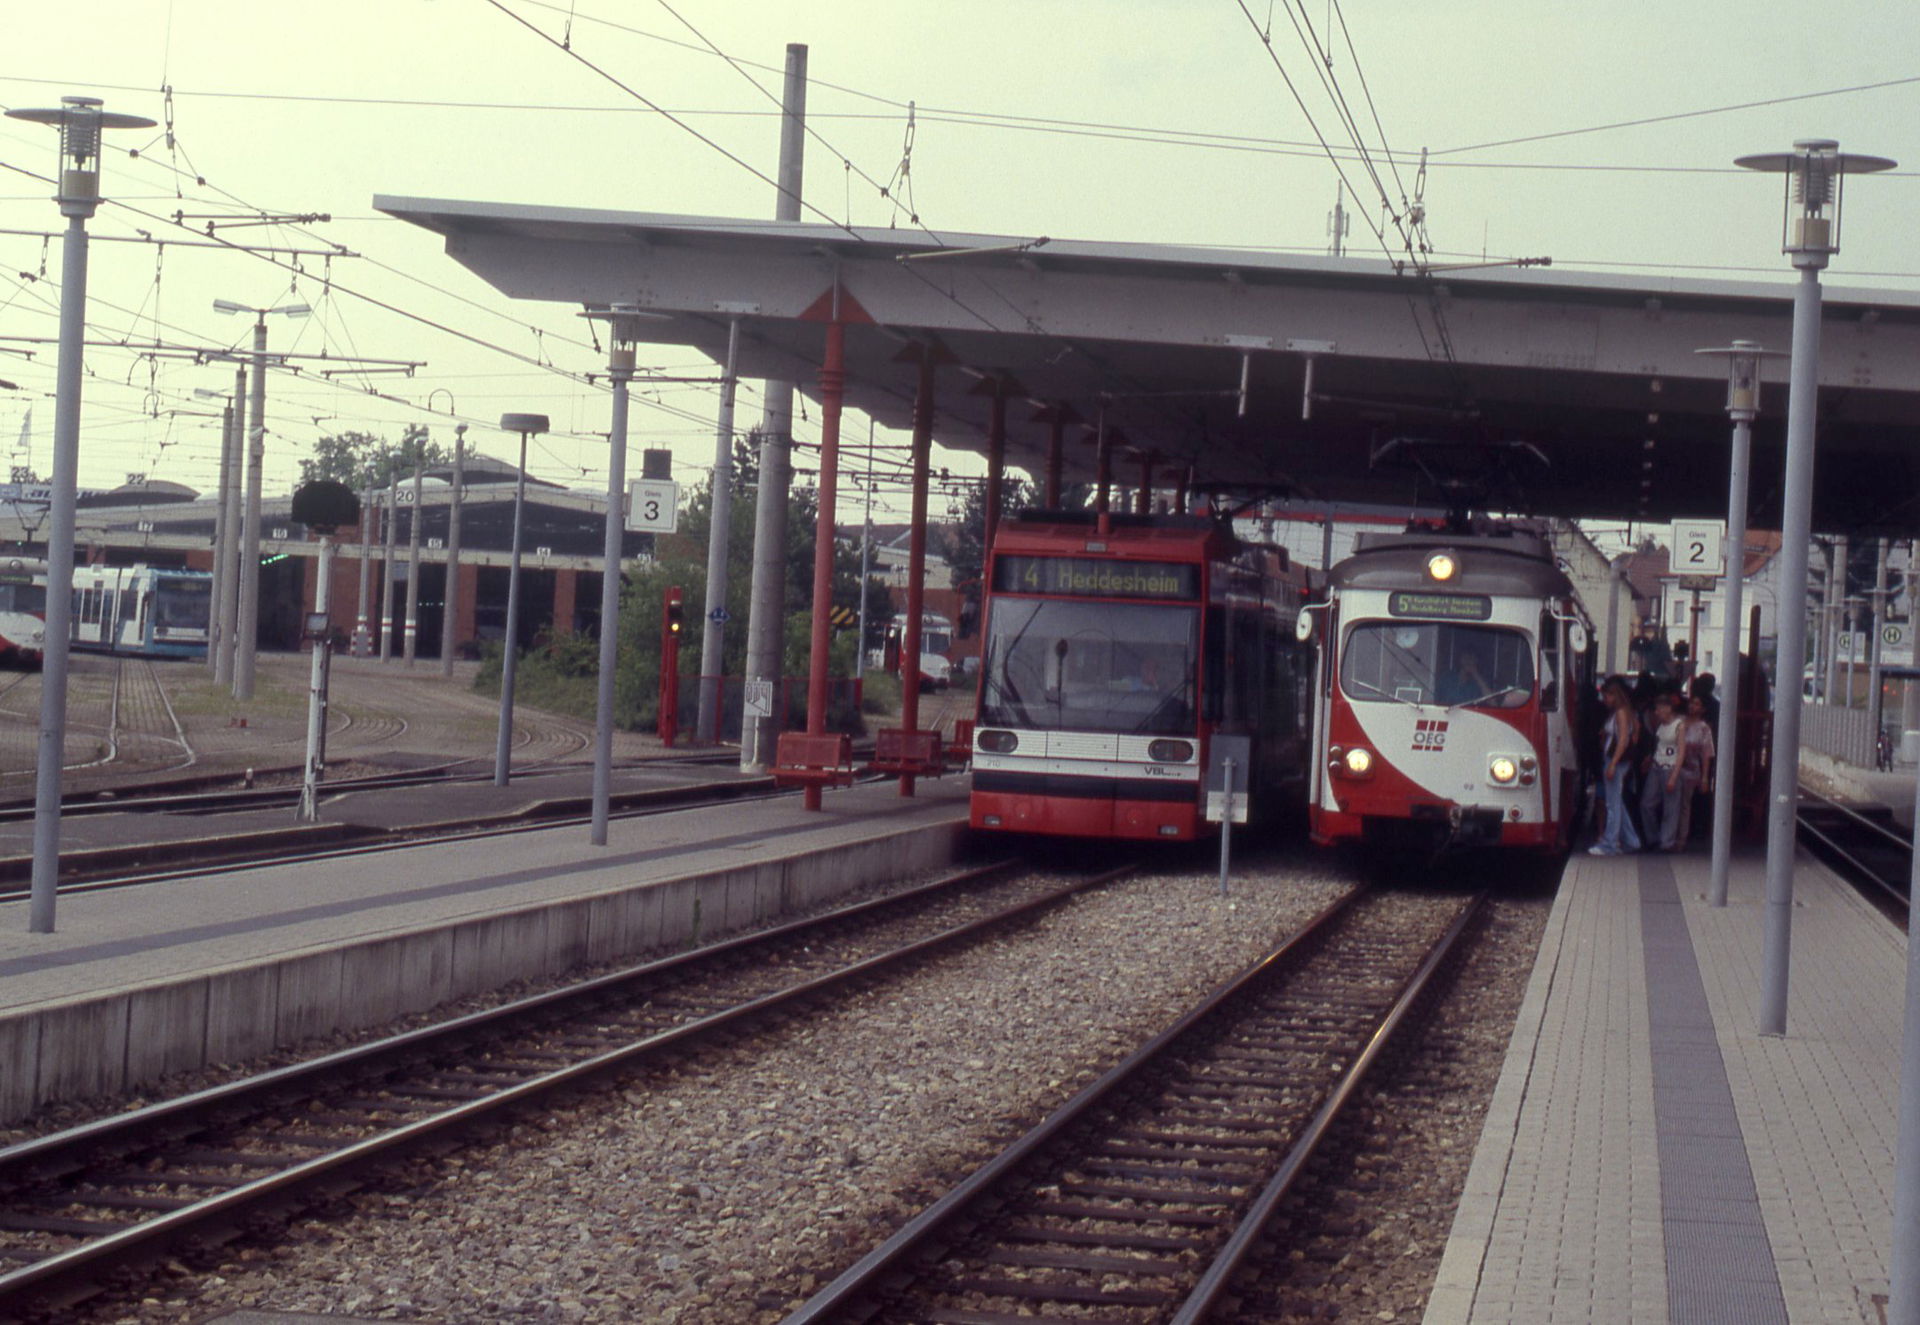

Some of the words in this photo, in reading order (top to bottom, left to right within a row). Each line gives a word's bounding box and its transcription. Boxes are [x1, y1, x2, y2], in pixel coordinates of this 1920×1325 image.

[127, 473, 145, 485] 22
[397, 490, 414, 502] 20
[645, 500, 659, 521] 3
[1690, 541, 1704, 563] 2
[1058, 566, 1180, 594] Heddesheim
[1413, 731, 1446, 745] OEG
